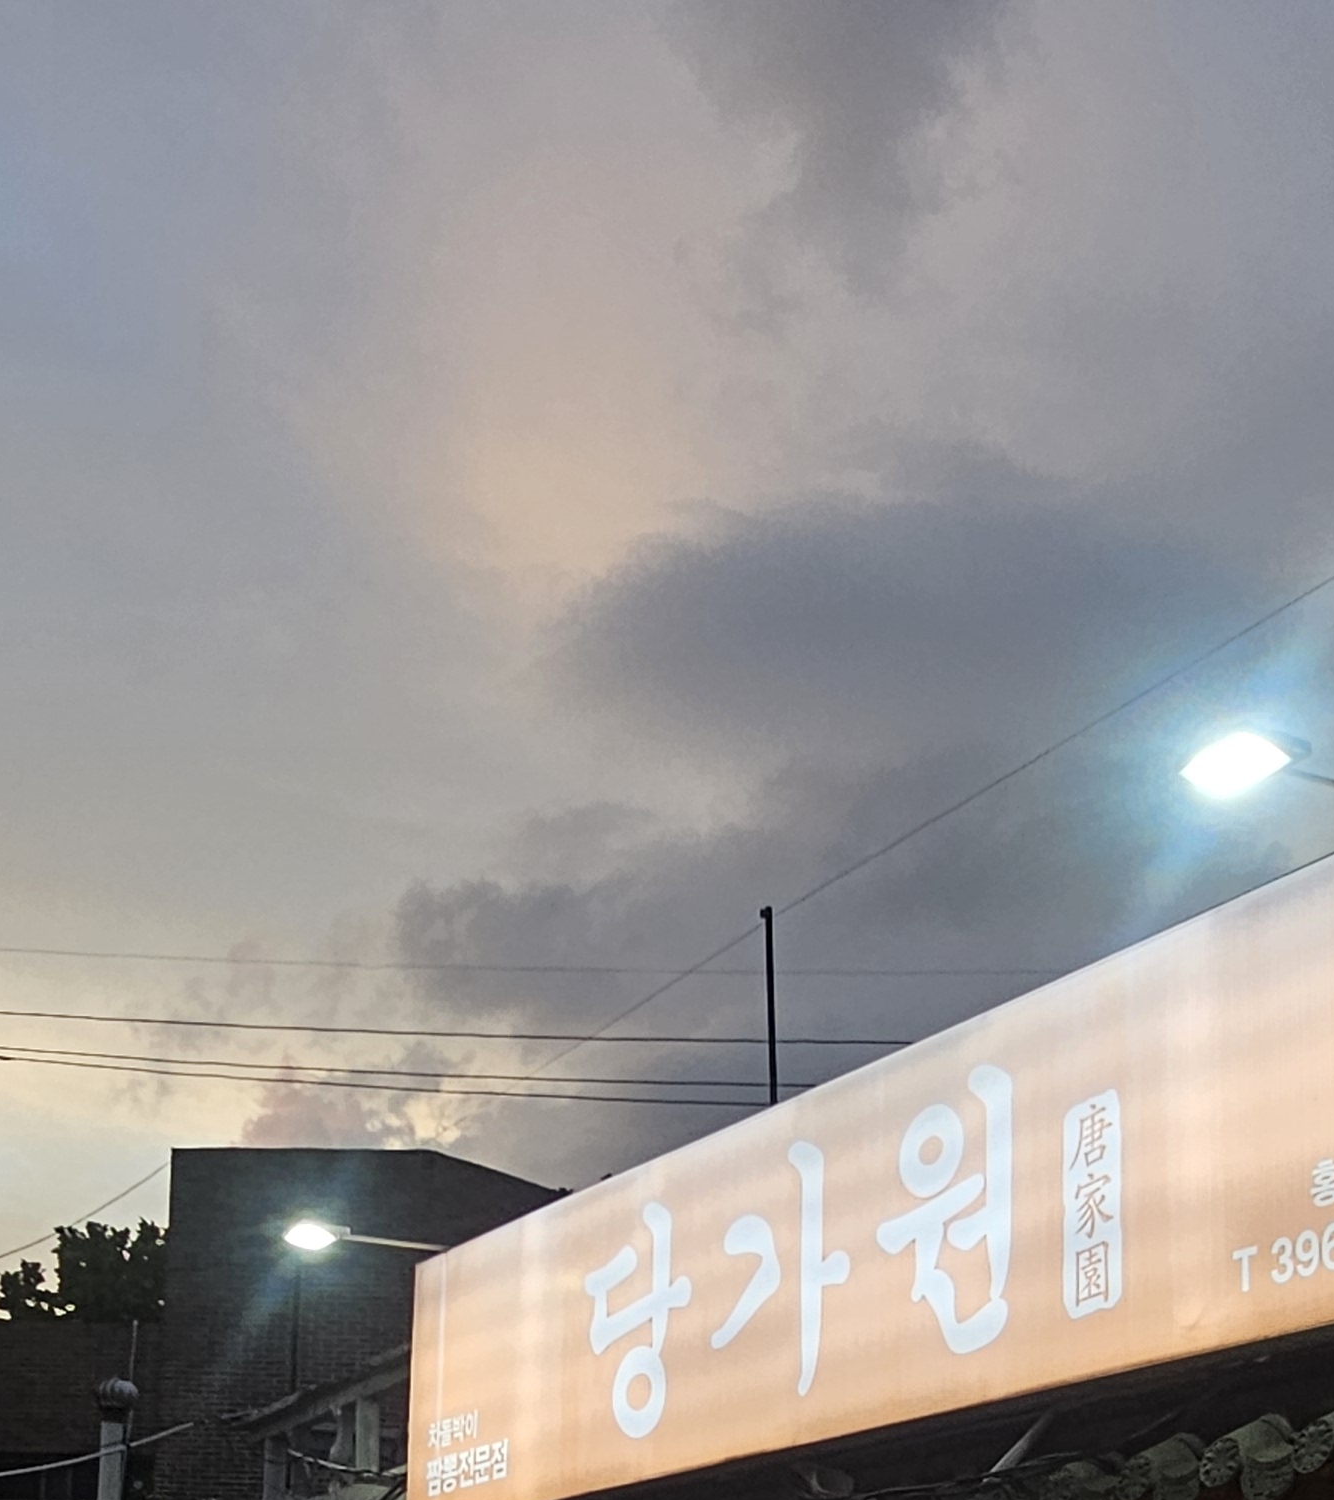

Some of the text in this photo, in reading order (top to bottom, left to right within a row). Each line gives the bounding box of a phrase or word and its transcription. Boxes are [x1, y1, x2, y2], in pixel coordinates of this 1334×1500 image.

[1069, 1103, 1115, 1308] 唐家園
[584, 1063, 1014, 1439] 당가원
[1231, 1246, 1258, 1292] T
[427, 1409, 478, 1448] 차돌박이
[426, 1437, 509, 1497] 짬뽕전문점
